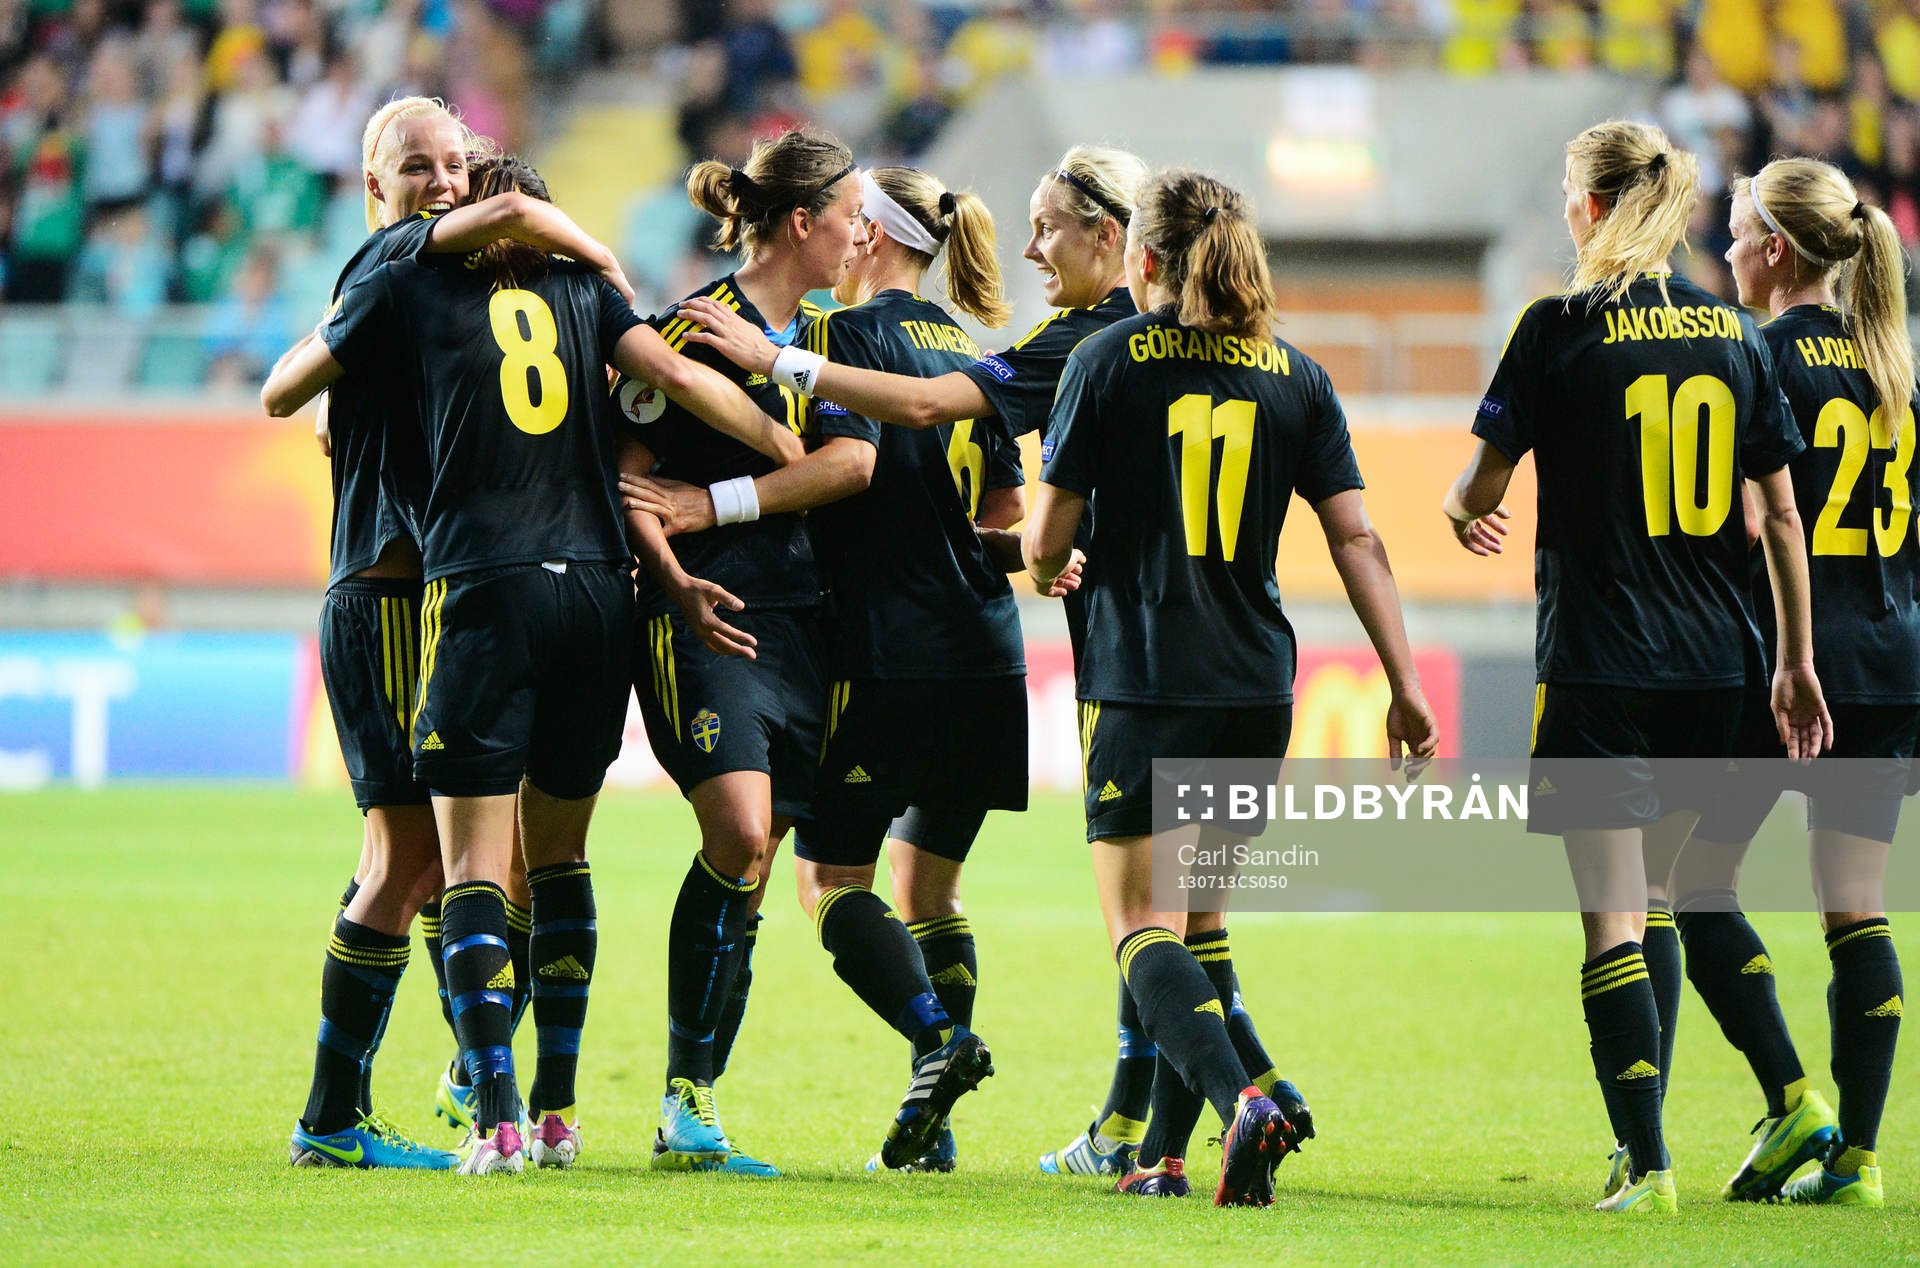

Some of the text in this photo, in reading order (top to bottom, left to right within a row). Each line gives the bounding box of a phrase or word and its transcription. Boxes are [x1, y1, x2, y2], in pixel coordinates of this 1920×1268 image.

[488, 289, 569, 435] 8
[1128, 324, 1292, 377] GÖRANSSON
[1602, 305, 1744, 345] JAKOBSSON
[1167, 393, 1258, 563] 11
[1625, 373, 1736, 537] 10
[1812, 397, 1917, 558] 23
[421, 742, 445, 751] adidas
[844, 775, 872, 783] adidas
